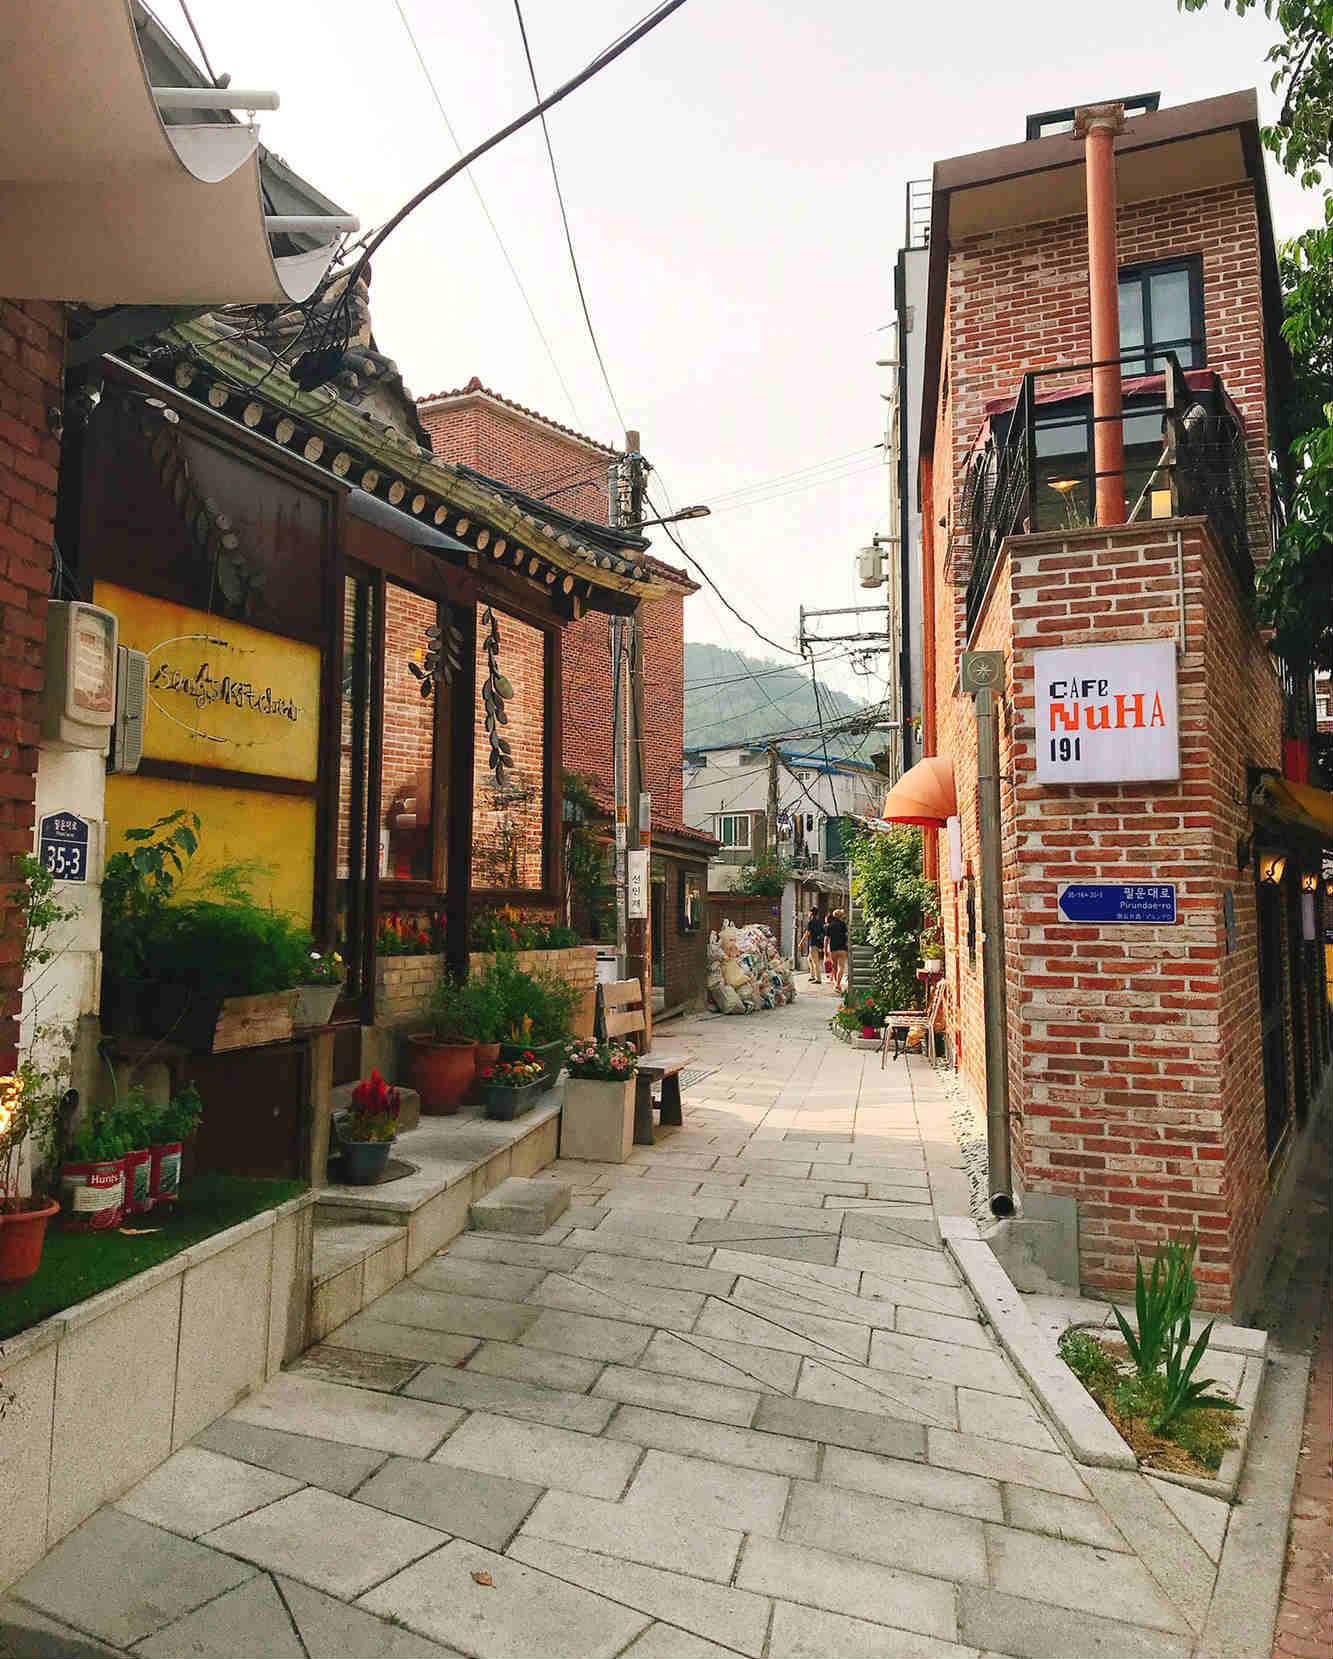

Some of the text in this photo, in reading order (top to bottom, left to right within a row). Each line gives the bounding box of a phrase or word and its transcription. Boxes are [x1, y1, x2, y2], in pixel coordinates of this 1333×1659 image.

[1050, 737, 1081, 762] 191
[47, 845, 80, 874] 35-3
[1123, 887, 1171, 900] 필운대로
[1119, 901, 1172, 910] Pirundae-ro
